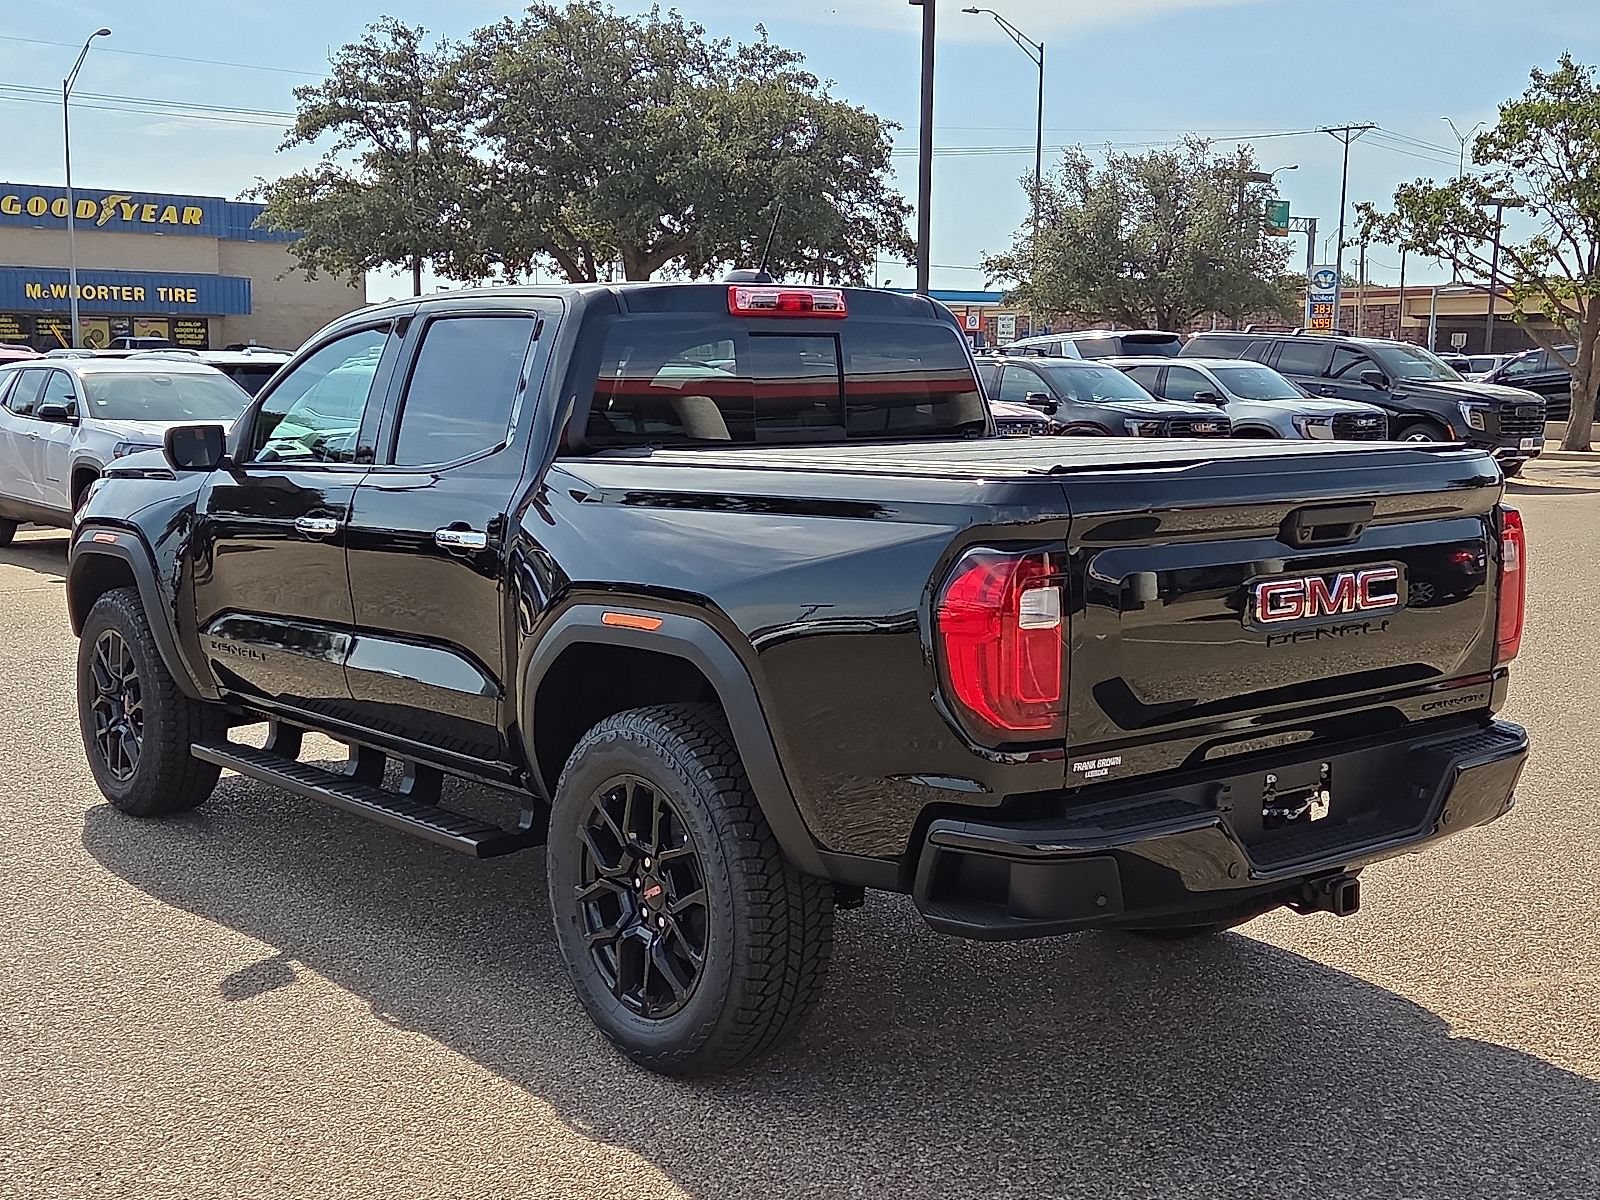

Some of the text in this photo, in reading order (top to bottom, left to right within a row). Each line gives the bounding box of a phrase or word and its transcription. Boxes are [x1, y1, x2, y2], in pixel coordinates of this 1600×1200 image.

[1, 194, 203, 226] GOODYEAR
[156, 287, 197, 303] TIRE
[1255, 567, 1399, 624] GMC
[1266, 619, 1390, 649] DENALI
[1421, 693, 1485, 712] CANYON
[1072, 755, 1122, 773] FRANK BROWN
